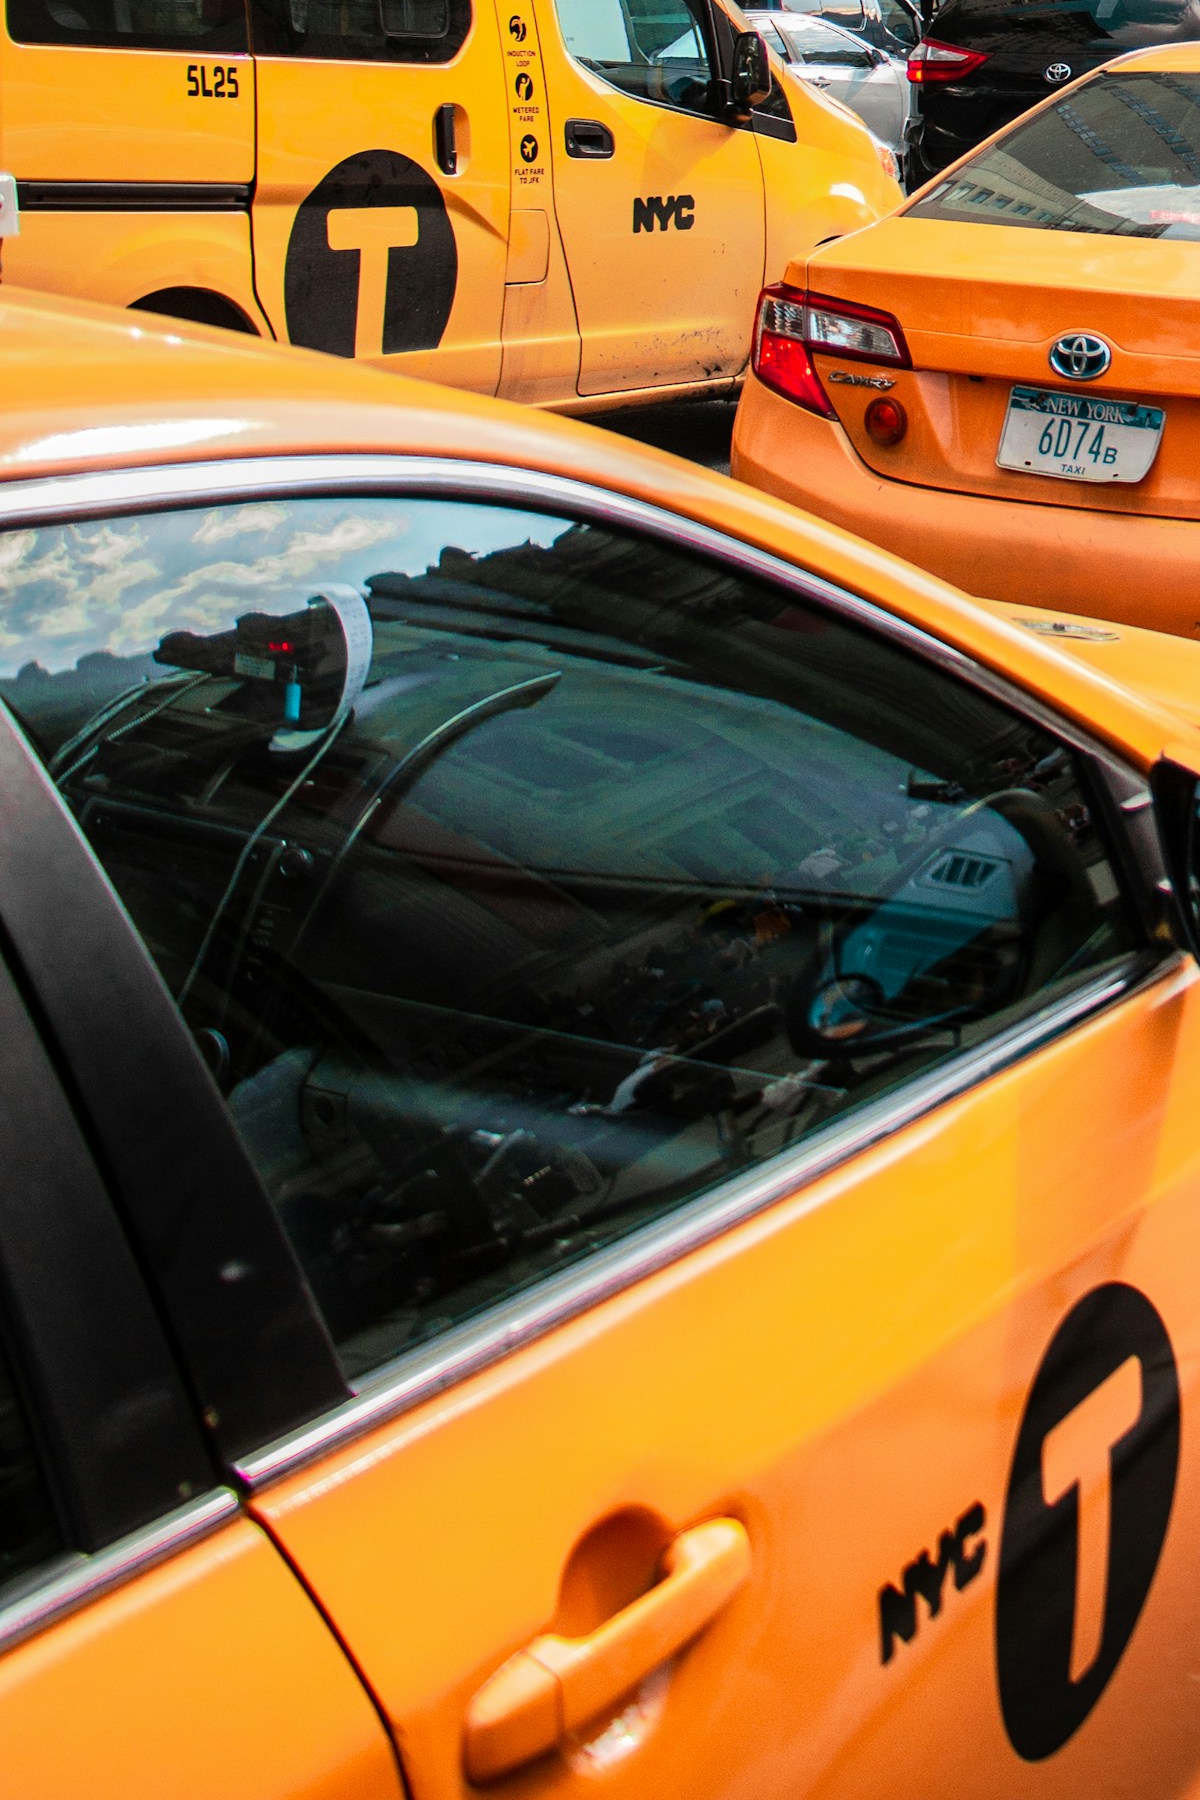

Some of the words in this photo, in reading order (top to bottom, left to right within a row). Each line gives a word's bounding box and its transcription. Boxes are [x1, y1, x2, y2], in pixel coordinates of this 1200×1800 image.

[632, 194, 695, 234] NYC
[327, 206, 419, 358] T
[1046, 397, 1083, 417] NEW
[1086, 402, 1126, 424] YORK
[1061, 463, 1086, 475] TAXI
[1041, 1354, 1143, 1684] T
[878, 1500, 987, 1666] NYC
